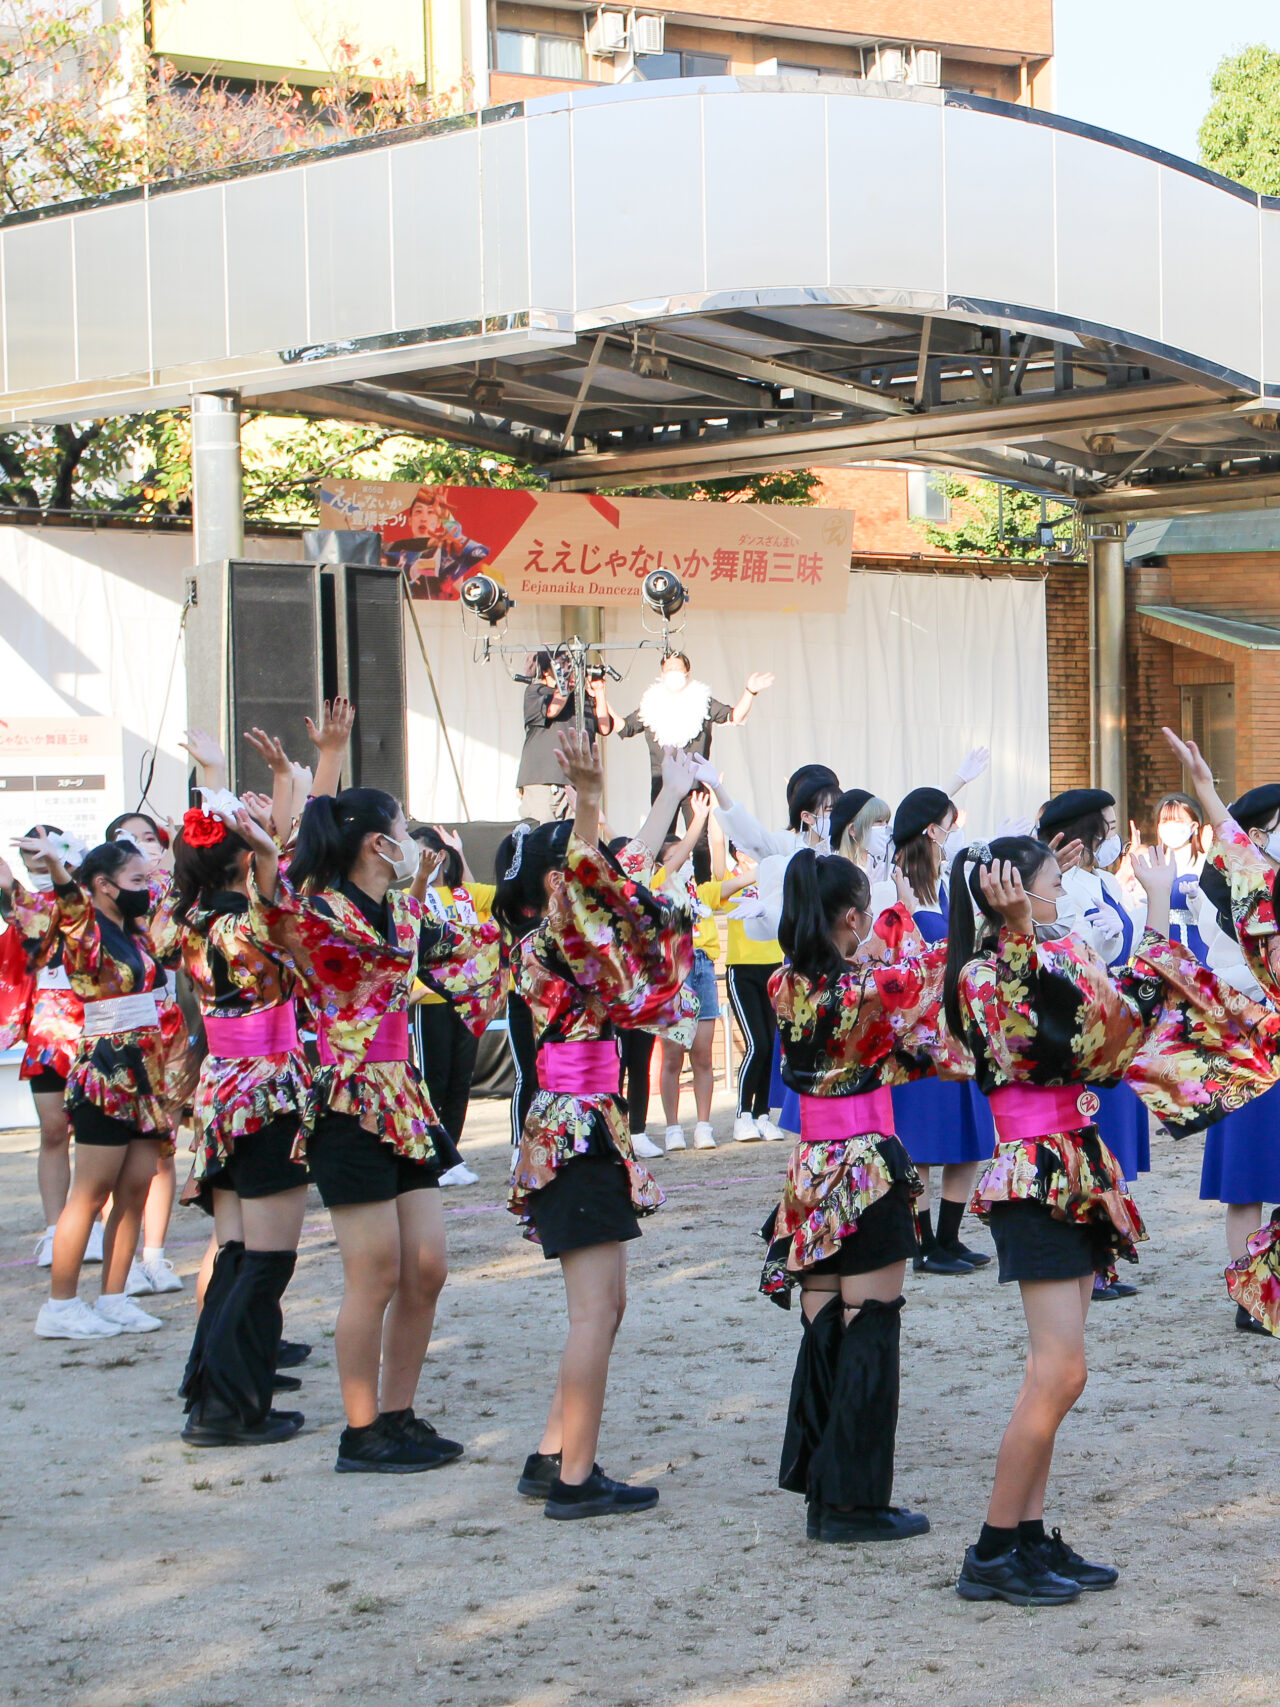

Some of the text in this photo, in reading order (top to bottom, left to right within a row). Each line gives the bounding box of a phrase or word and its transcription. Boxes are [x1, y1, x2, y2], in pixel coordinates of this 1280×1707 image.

[738, 534, 800, 548] ダンスざんまい
[523, 538, 824, 585] ええじゃないか舞踊三昧
[521, 579, 643, 596] Eejanaika Danceza
